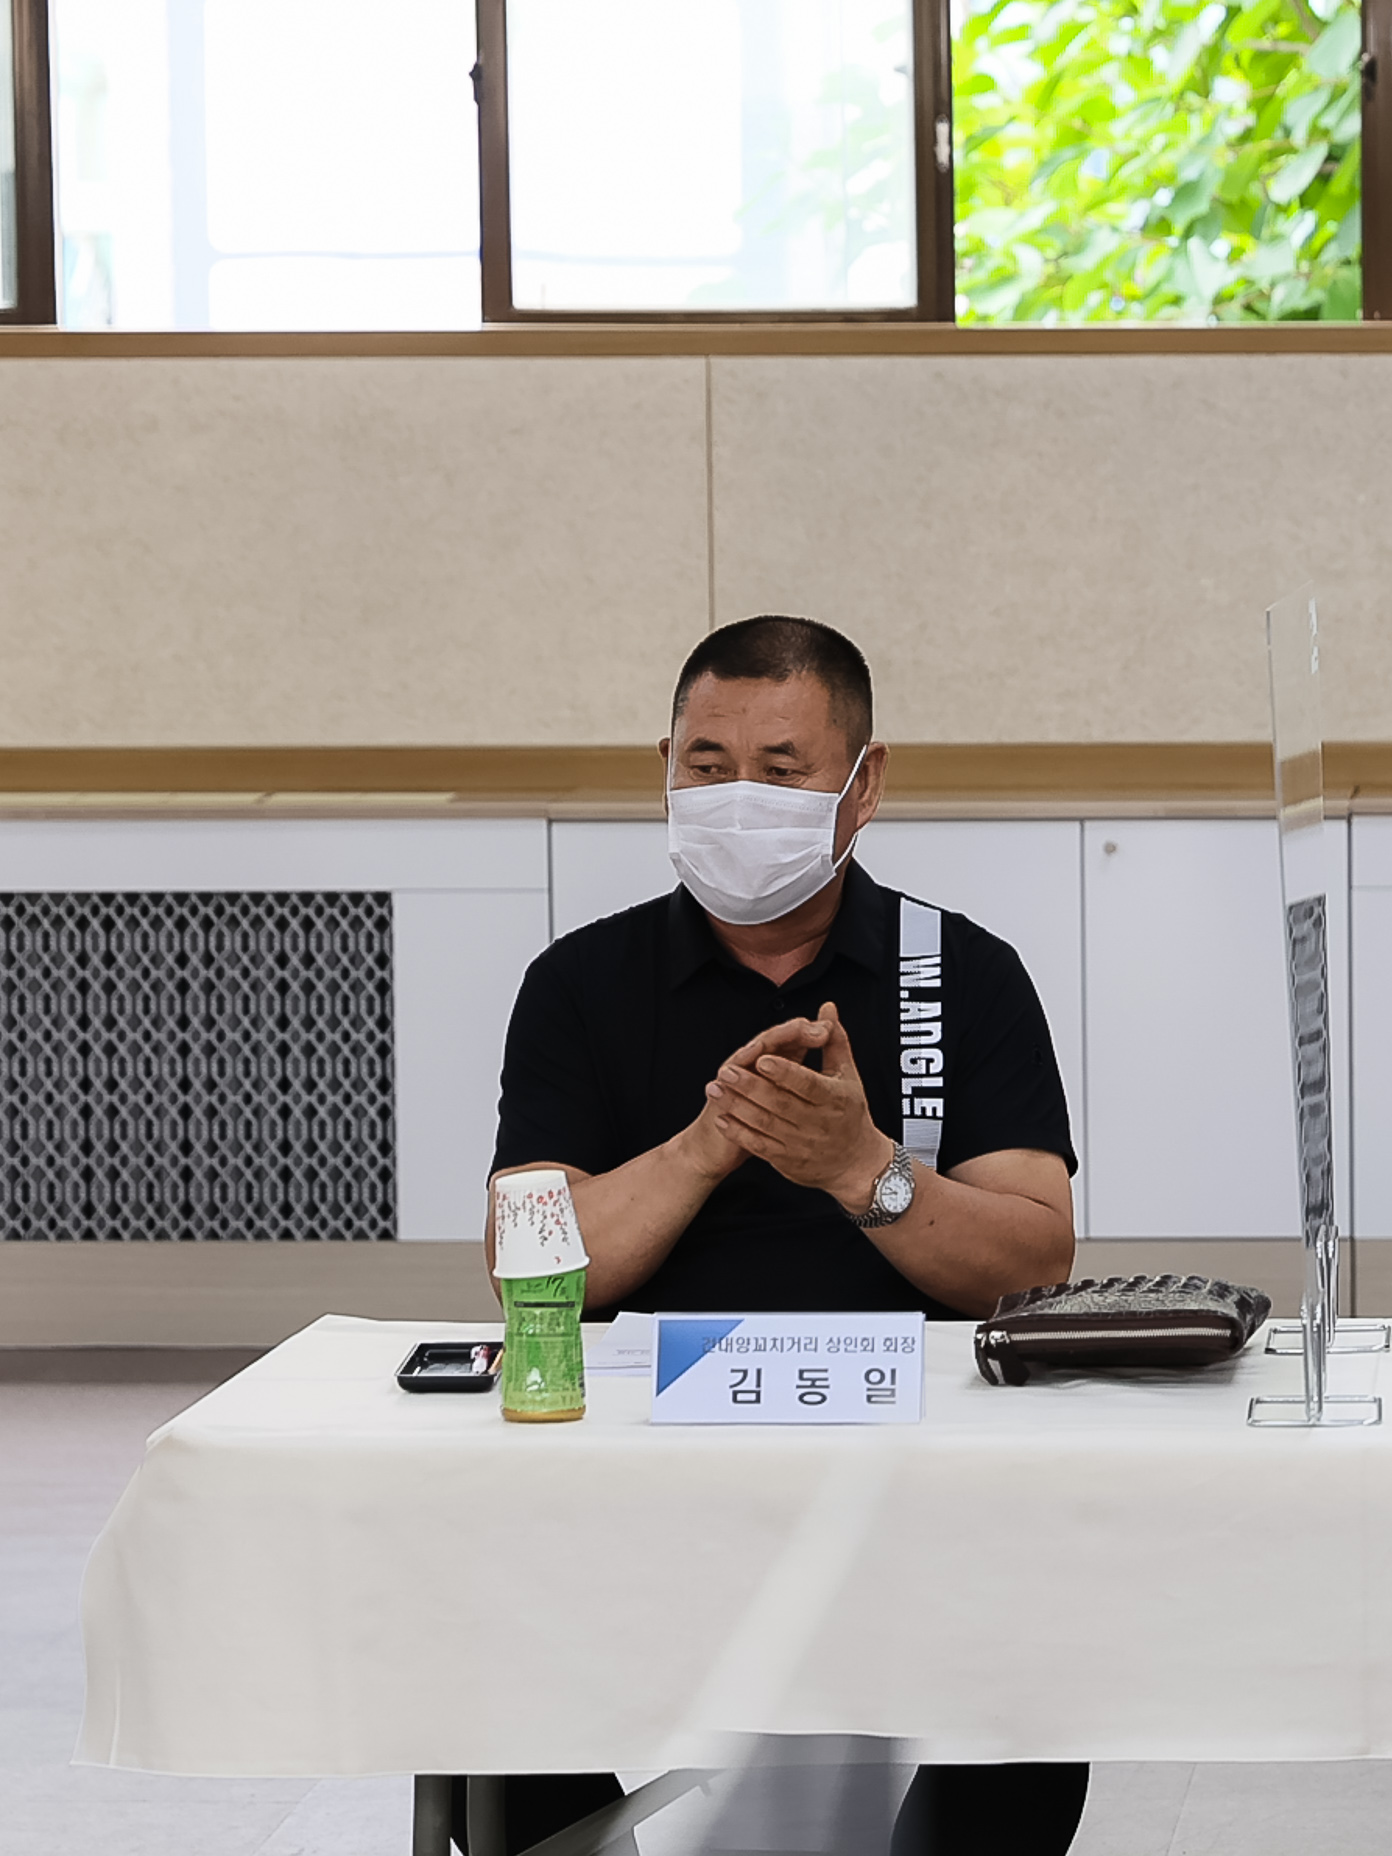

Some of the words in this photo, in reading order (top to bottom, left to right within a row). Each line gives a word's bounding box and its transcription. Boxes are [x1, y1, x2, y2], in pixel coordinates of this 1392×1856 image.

[701, 1336, 819, 1354] 건대양꼬치거리
[825, 1336, 875, 1354] 상인회
[882, 1336, 916, 1354] 회장
